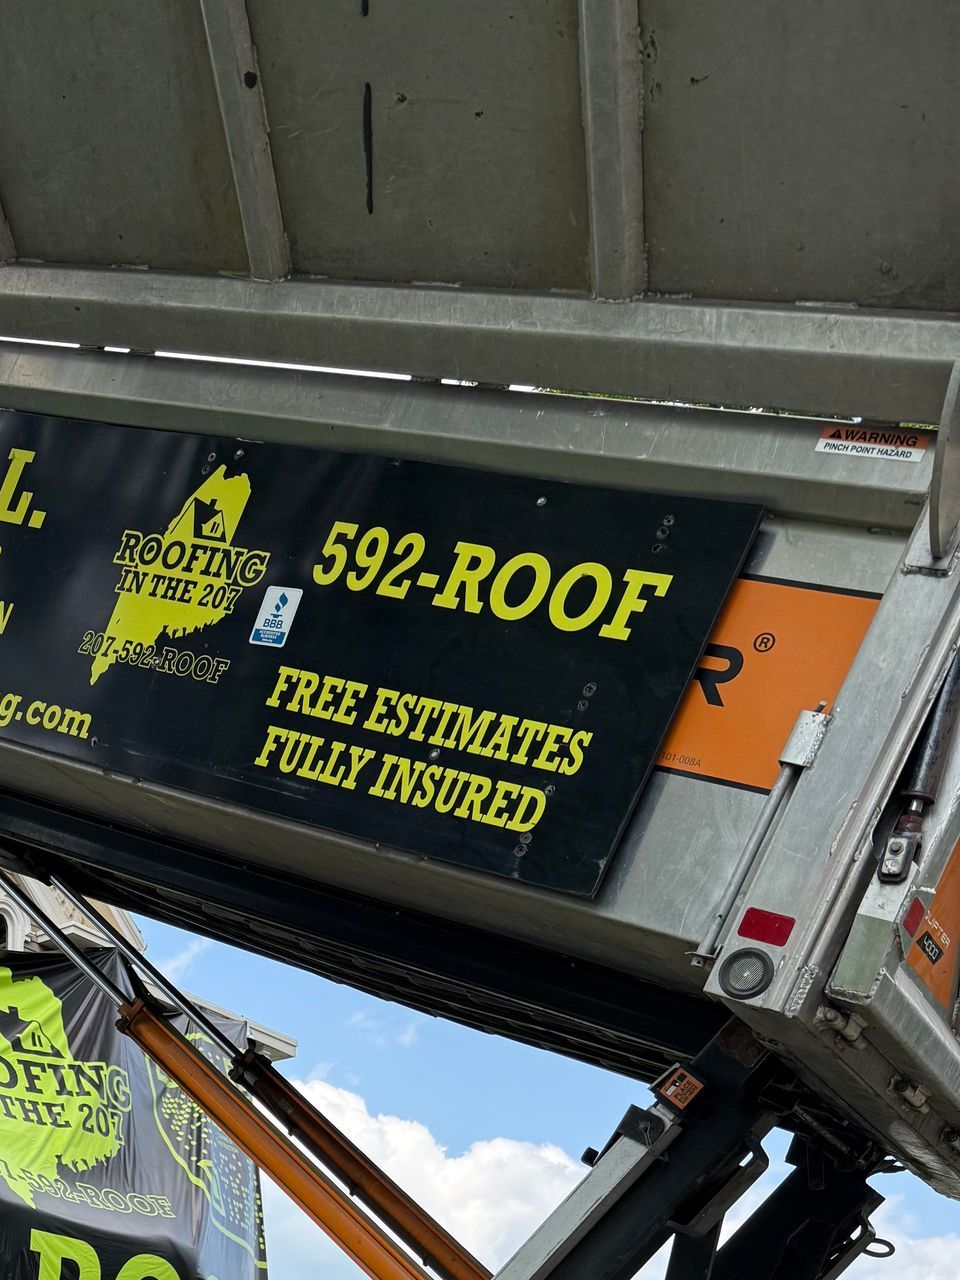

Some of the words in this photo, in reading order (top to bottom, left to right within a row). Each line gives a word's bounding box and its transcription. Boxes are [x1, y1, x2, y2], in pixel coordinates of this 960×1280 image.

[823, 442, 849, 452] PINCH
[850, 445, 876, 455] POINT
[877, 448, 913, 459] HAZARD
[845, 429, 919, 447] WARNING
[113, 530, 271, 587] ROOFING
[115, 567, 148, 596] IN
[148, 574, 198, 604] THE
[198, 583, 243, 614] 207
[313, 520, 673, 641] 592-ROOF
[263, 618, 284, 629] BBB
[78, 630, 230, 684] 207-592-ROOF
[266, 665, 366, 727] FREE
[364, 688, 593, 777] ESTIMATES
[254, 726, 371, 790] FULLY
[371, 761, 547, 834] INSURED
[923, 936, 939, 960] 4000
[674, 1080, 692, 1099] PLACE
[78, 1103, 125, 1143] 207
